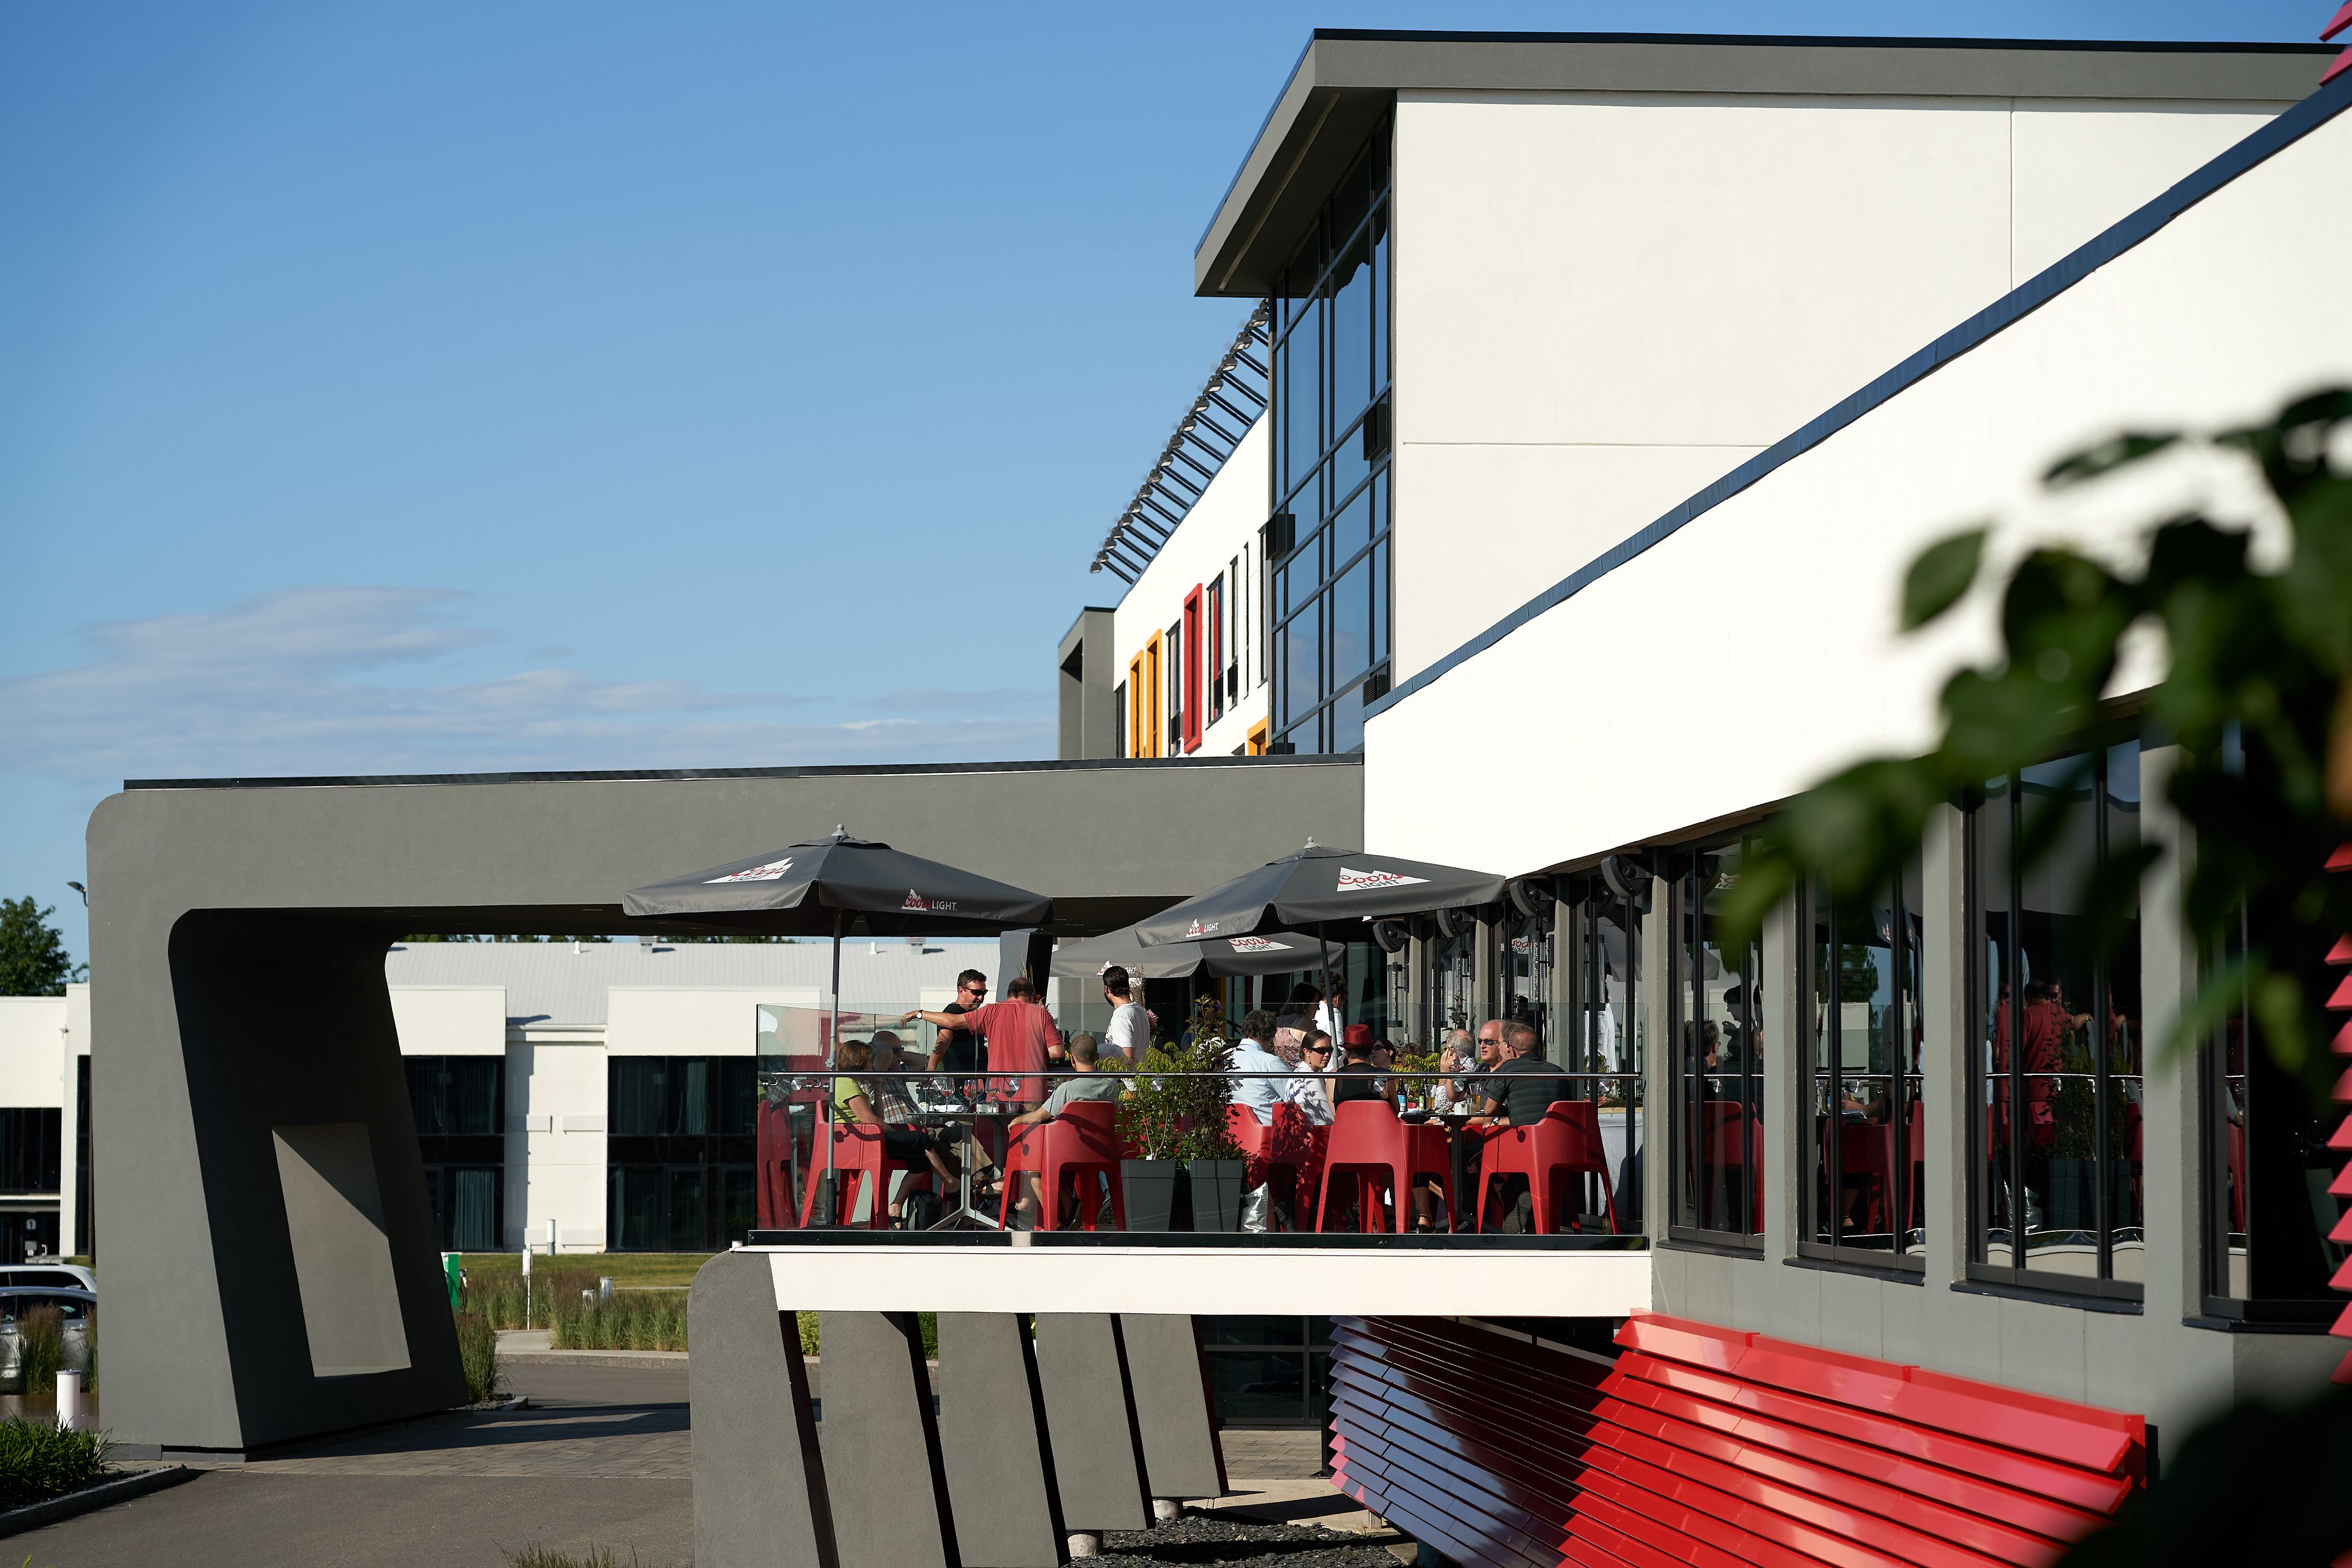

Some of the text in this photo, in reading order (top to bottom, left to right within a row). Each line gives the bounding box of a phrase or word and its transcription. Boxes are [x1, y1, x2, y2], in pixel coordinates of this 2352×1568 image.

[1338, 873, 1403, 884] Coors
[1356, 880, 1398, 888] LIGHT
[932, 900, 957, 911] LIGHT
[1204, 922, 1218, 933] LIGHT
